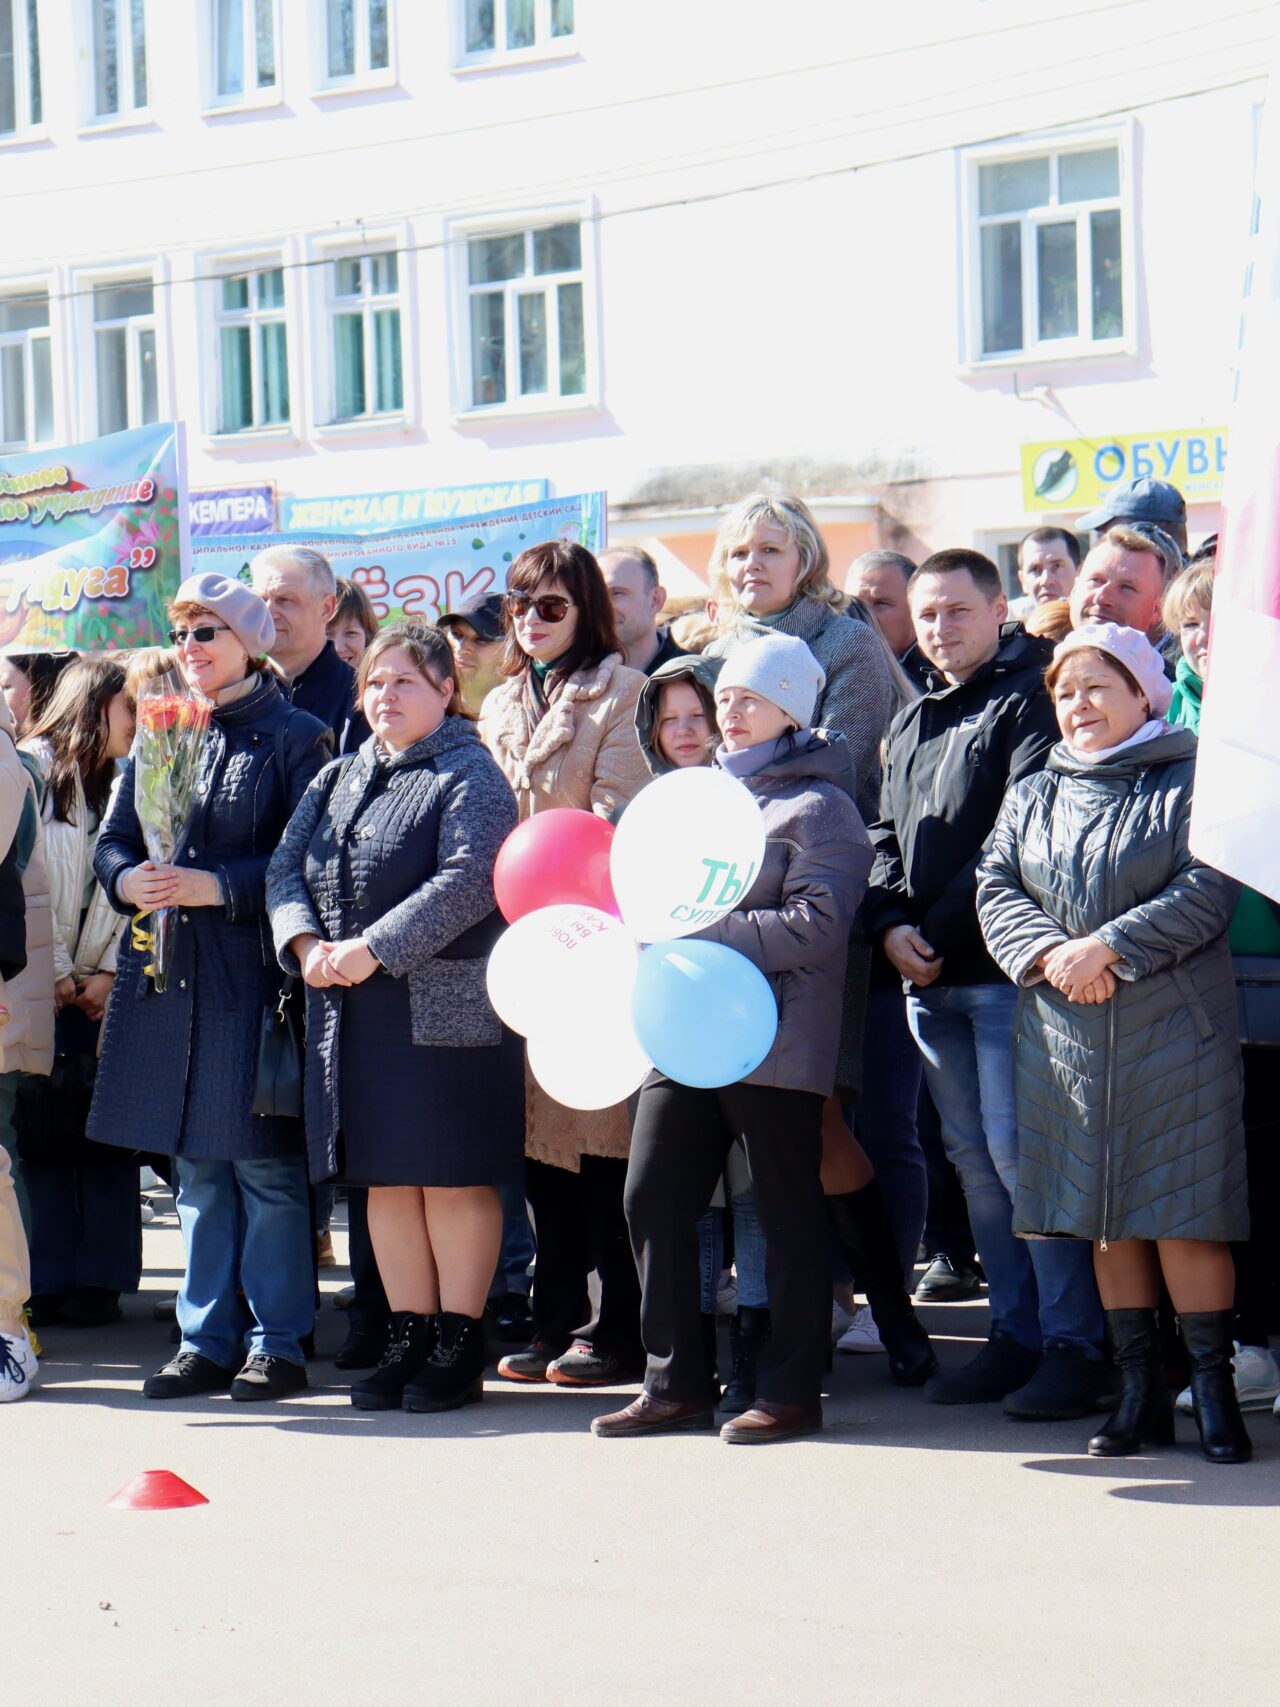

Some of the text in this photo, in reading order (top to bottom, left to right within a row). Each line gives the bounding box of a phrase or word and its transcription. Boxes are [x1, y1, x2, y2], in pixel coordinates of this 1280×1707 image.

[31, 478, 154, 525] учреждение
[288, 482, 543, 530] ЖЕНСКАЯ И МУЖСКАЯ
[521, 508, 562, 522] ДЕТСКИЙ
[406, 540, 432, 551] ВИДА
[695, 857, 756, 906] ТЫ
